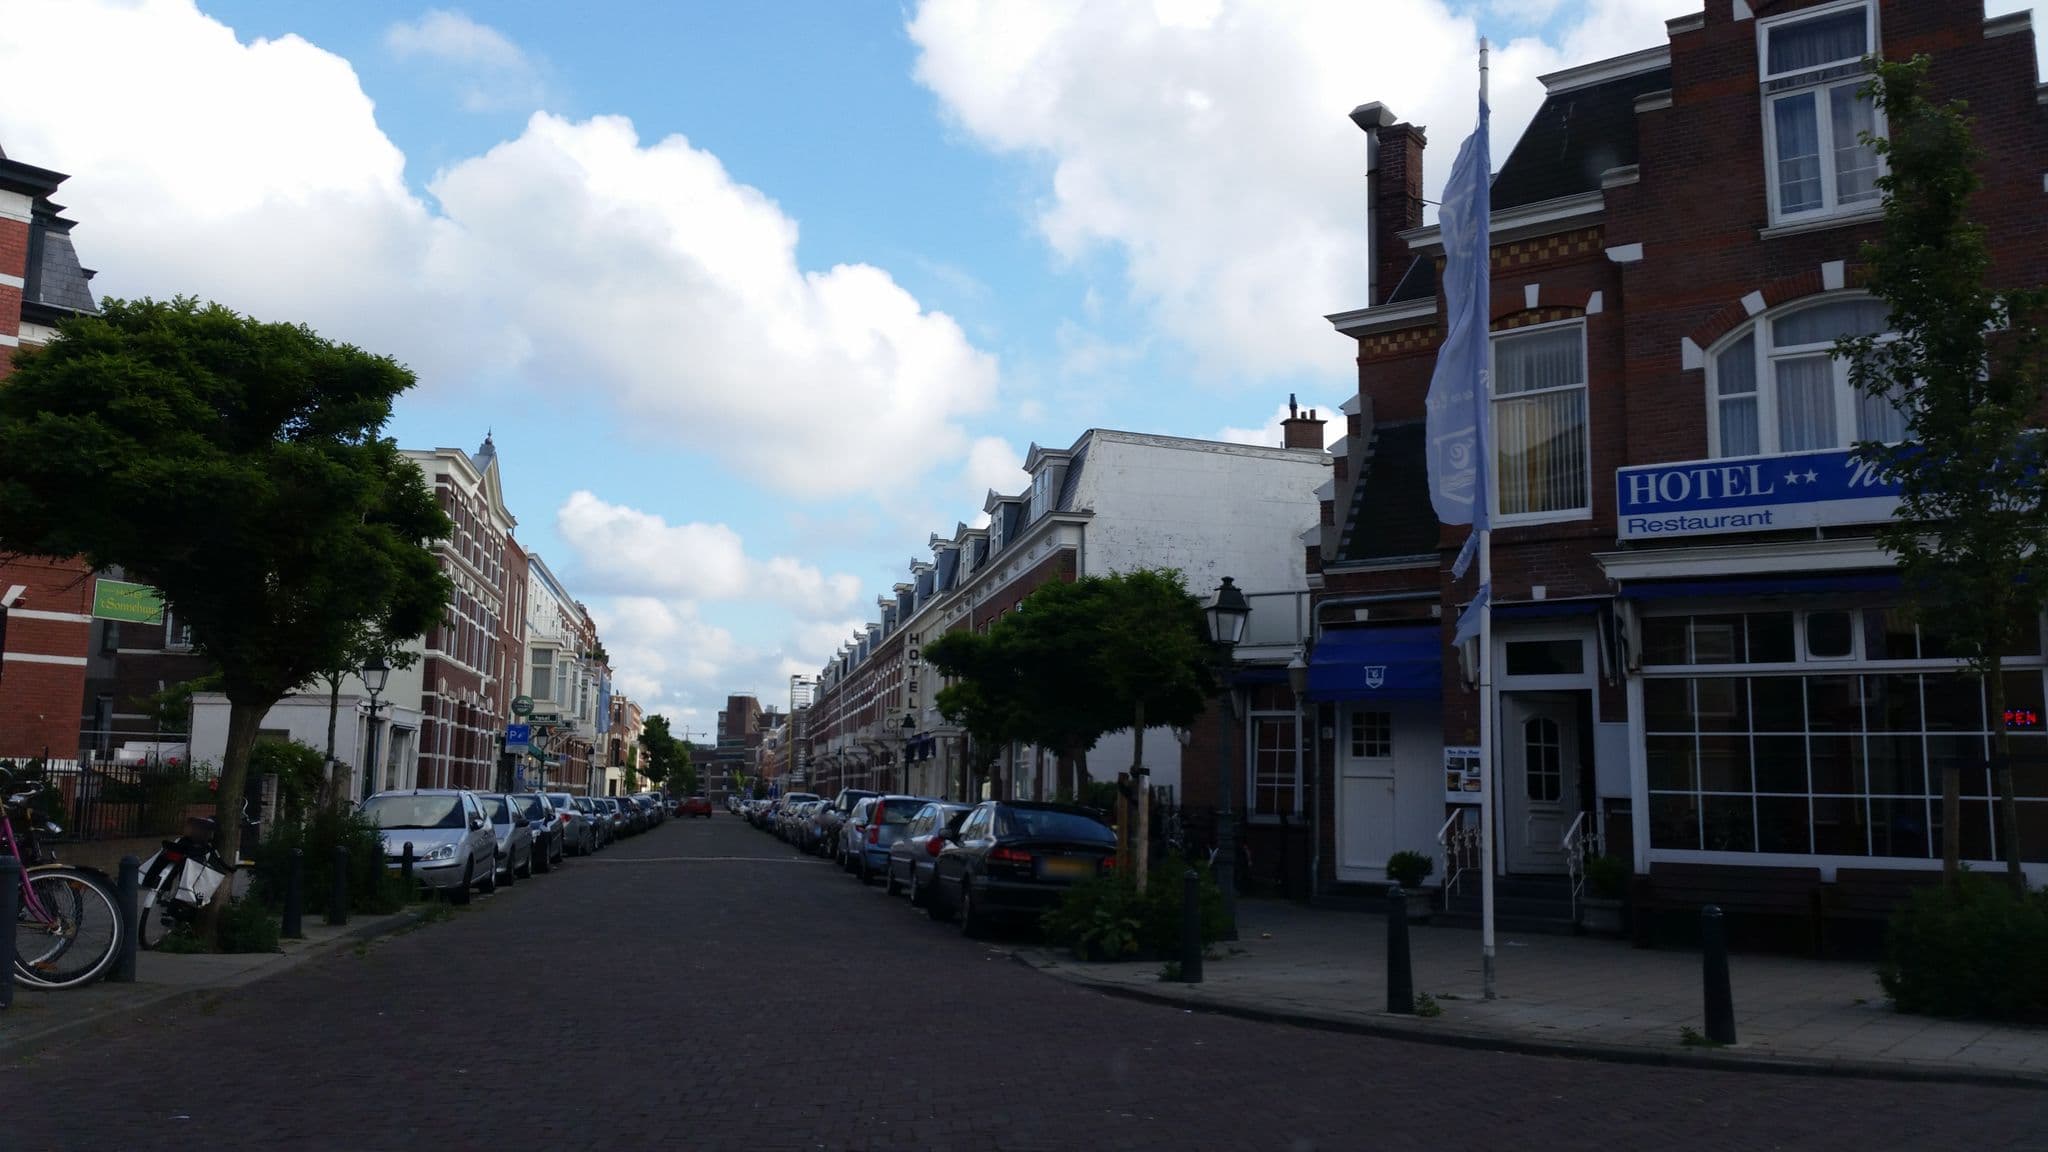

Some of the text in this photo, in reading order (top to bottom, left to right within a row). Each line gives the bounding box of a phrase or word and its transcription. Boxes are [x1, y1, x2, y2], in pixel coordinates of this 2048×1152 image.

[1628, 464, 1775, 506] HOTEL
[1628, 509, 1773, 535] Restaurant
[909, 633, 920, 709] HOTEL
[2003, 710, 2038, 726] PEN
